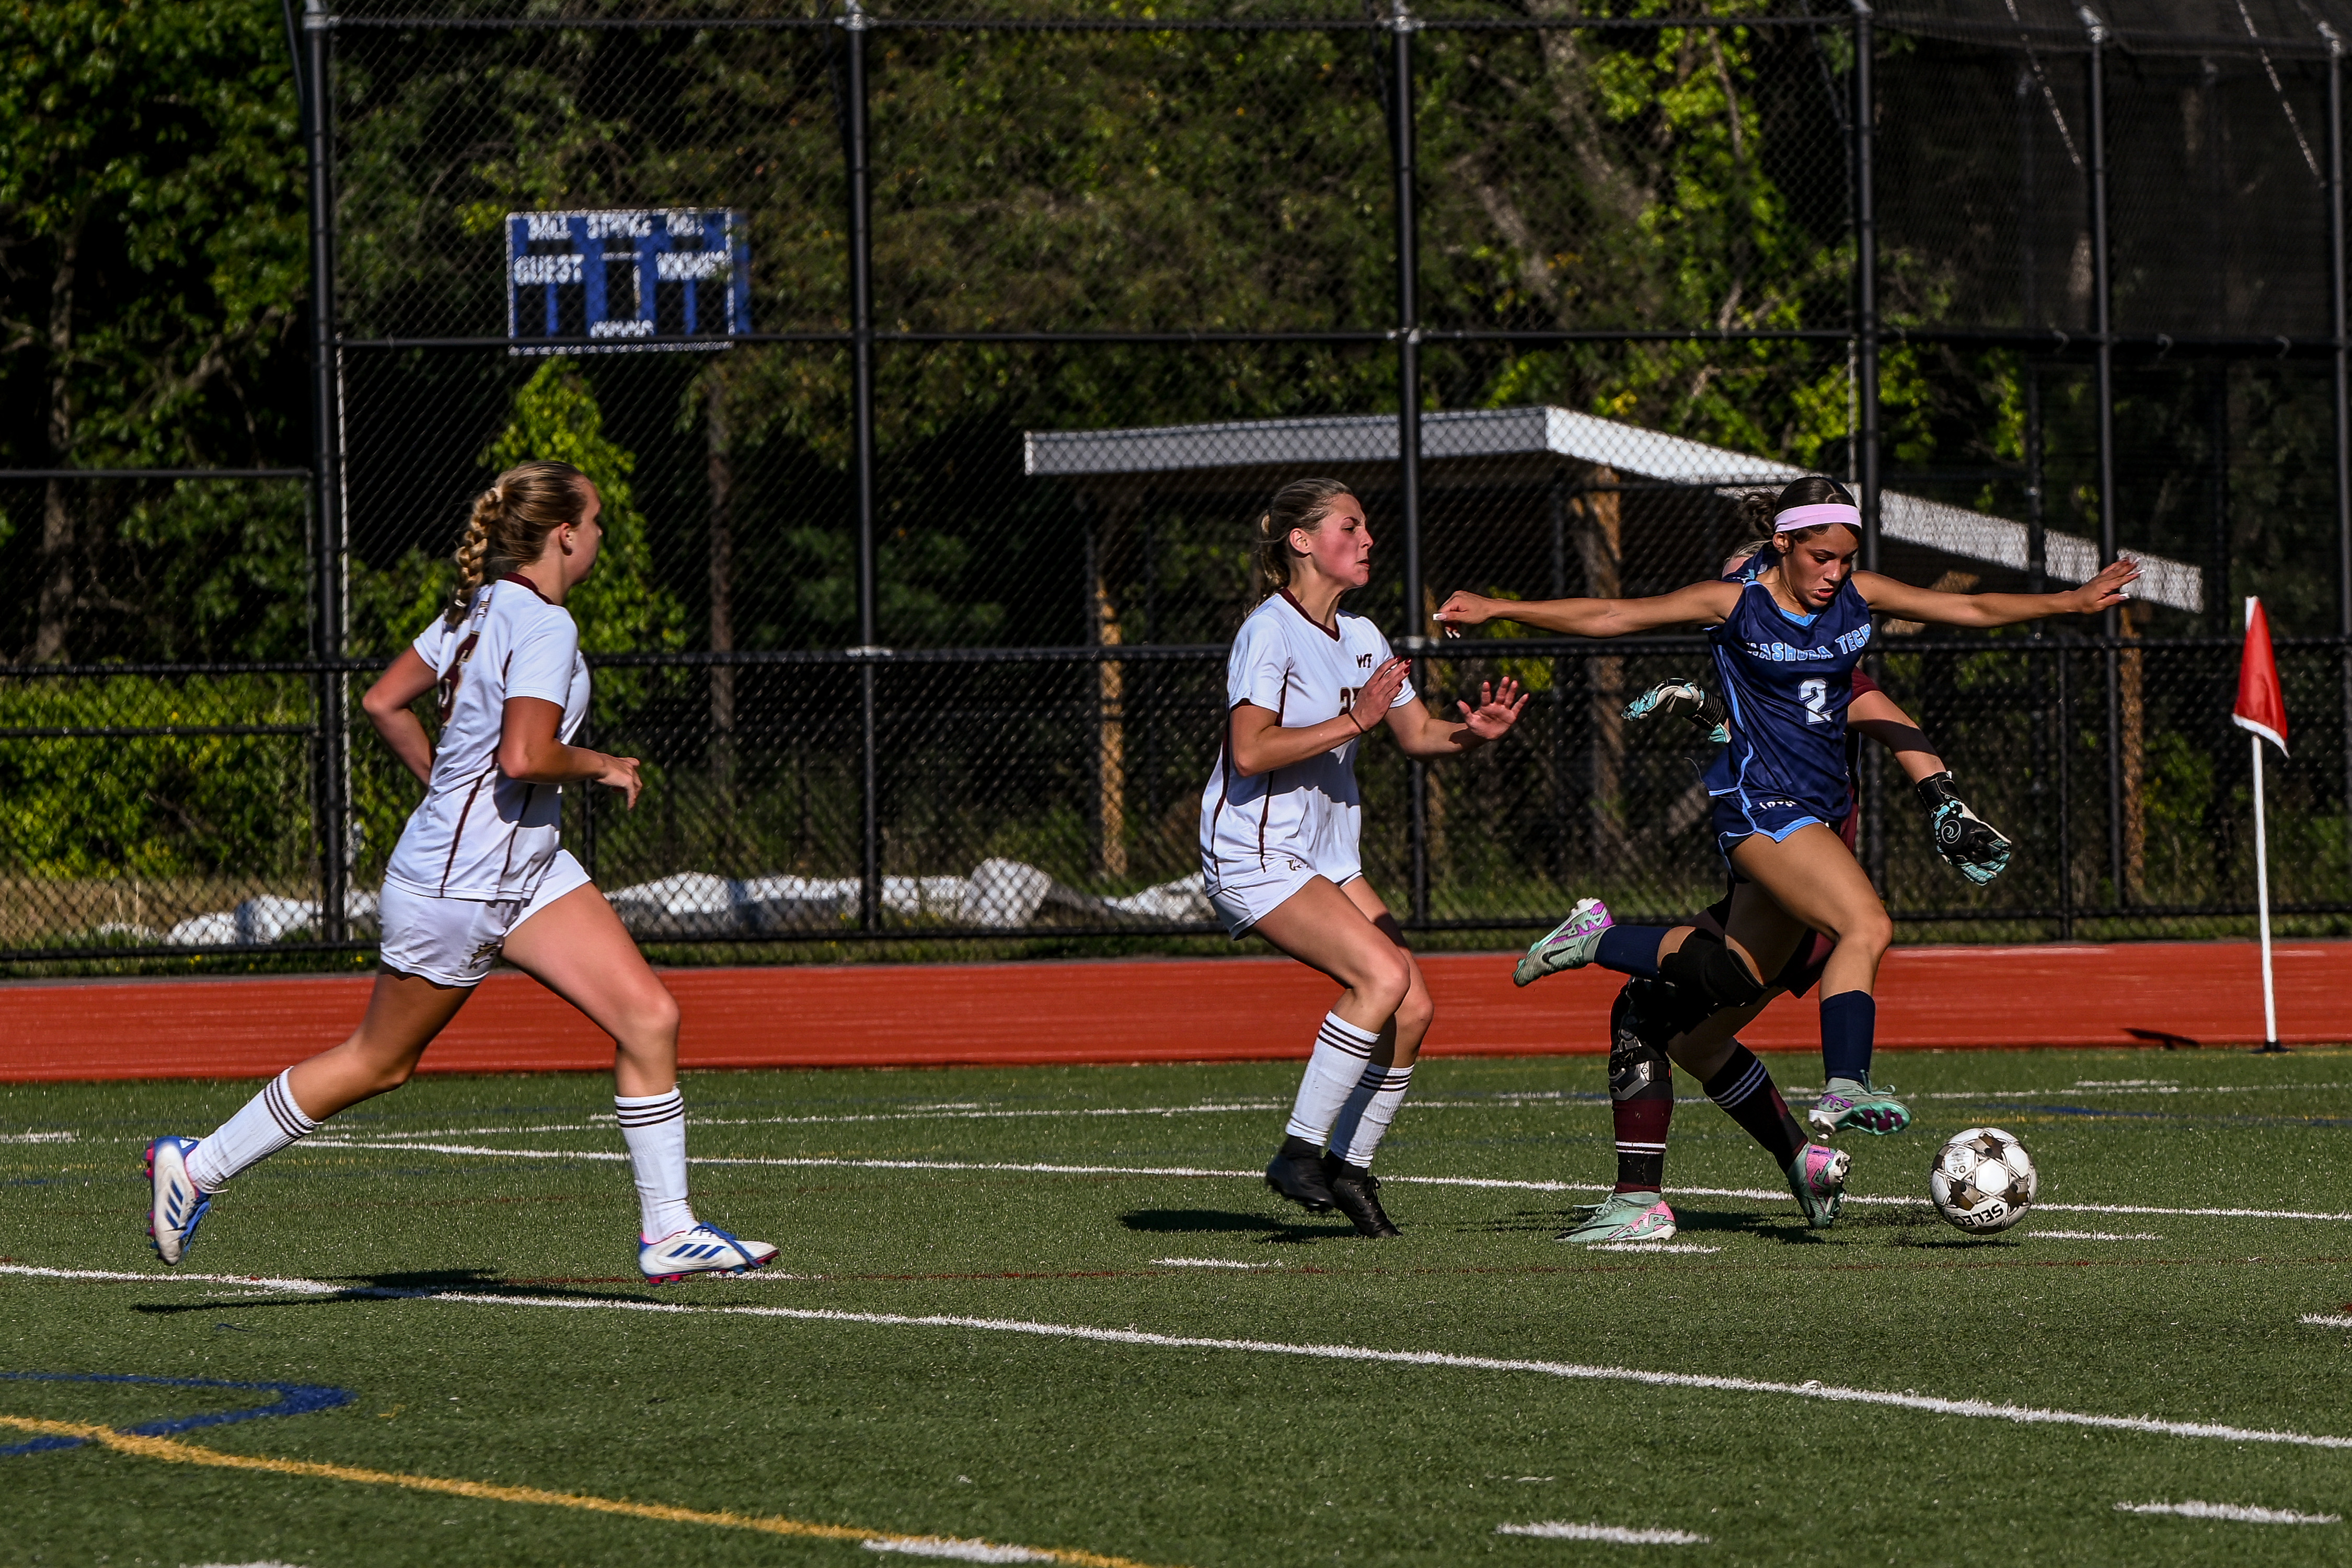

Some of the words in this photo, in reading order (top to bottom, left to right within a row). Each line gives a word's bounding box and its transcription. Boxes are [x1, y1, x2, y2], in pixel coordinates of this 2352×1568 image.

[1835, 623, 1871, 655] TECH
[1798, 677, 1833, 725] 2
[1947, 1203, 2004, 1226] SELECT
